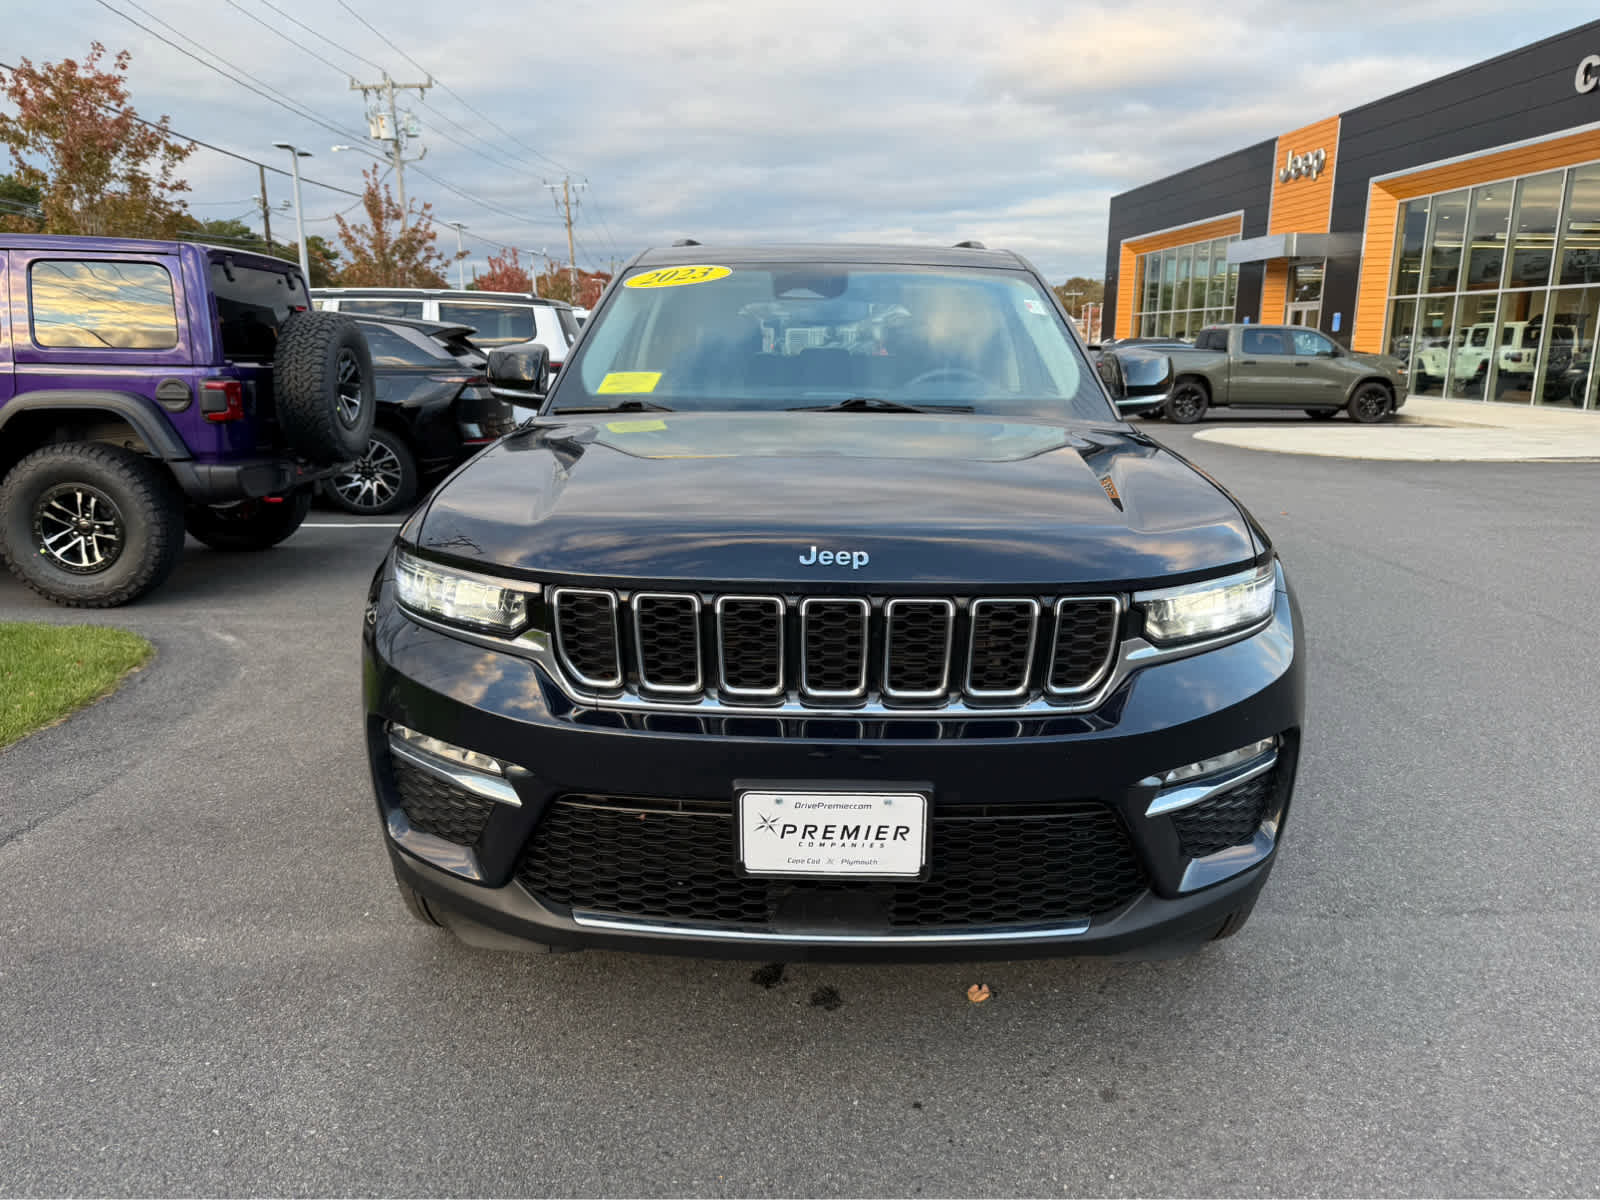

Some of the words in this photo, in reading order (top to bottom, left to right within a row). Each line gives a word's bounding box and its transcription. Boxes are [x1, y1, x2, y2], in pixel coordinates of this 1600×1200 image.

[1575, 54, 1600, 94] C
[1279, 148, 1326, 184] Jeep
[639, 267, 714, 285] 2023
[799, 545, 870, 570] Jeep
[780, 824, 910, 841] PREMIER
[798, 841, 886, 849] COMPANIES
[787, 857, 806, 866] Cape
[806, 857, 821, 865] Cod
[840, 857, 879, 866] Plymouth
